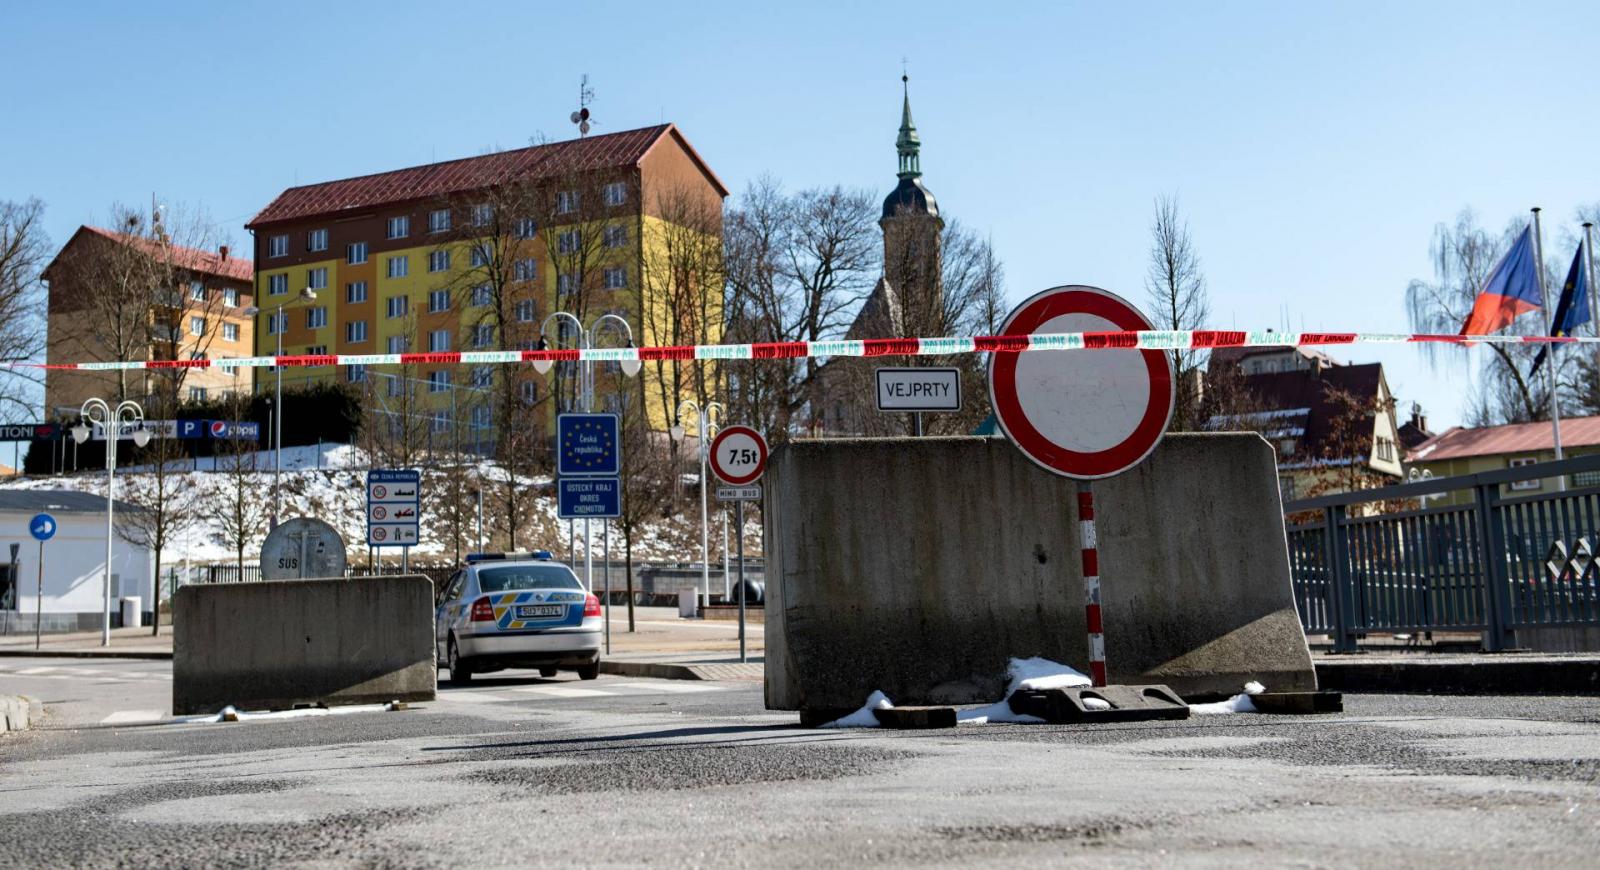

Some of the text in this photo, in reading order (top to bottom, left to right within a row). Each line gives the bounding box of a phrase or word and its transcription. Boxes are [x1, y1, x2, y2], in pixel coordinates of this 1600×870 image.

[1192, 332, 1214, 346] VSTUP
[886, 382, 950, 397] VEJPRTY
[184, 422, 194, 434] P
[580, 434, 597, 443] Česká
[574, 446, 602, 455] republika
[729, 448, 758, 466] 7,5t
[566, 482, 612, 492] ÚSTECKÝ KRAJ
[580, 494, 600, 502] OKRES
[574, 504, 606, 513] CHOMUTOV
[278, 558, 298, 568] SUS
